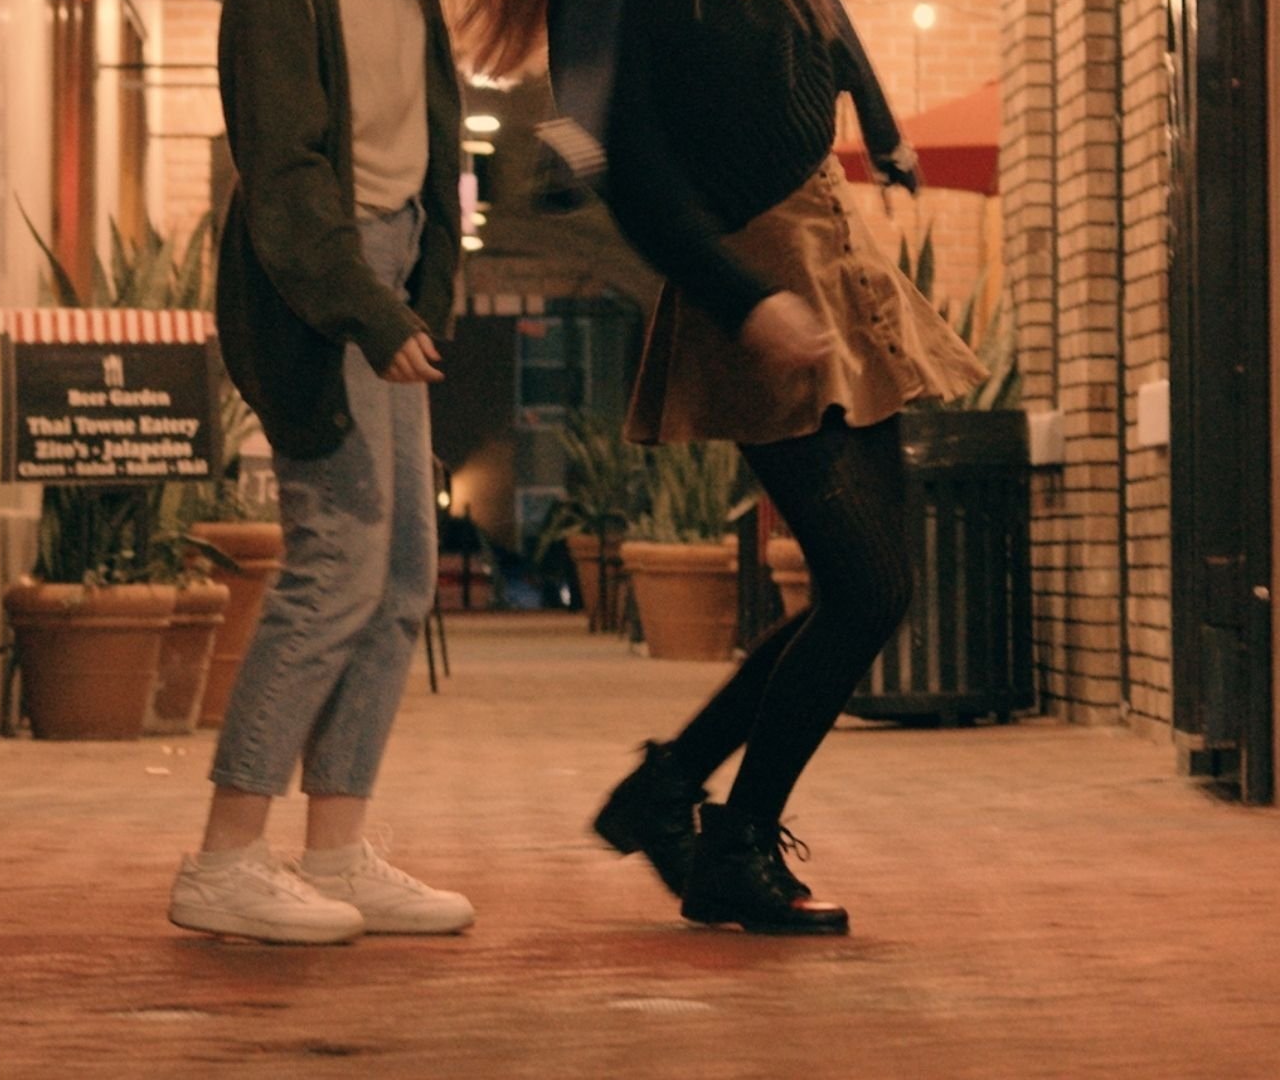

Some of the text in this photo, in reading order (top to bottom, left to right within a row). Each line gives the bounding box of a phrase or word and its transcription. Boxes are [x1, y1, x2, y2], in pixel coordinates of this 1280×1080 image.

[67, 388, 171, 407] Beer Garden
[26, 415, 200, 438] Thai Towne Eatery
